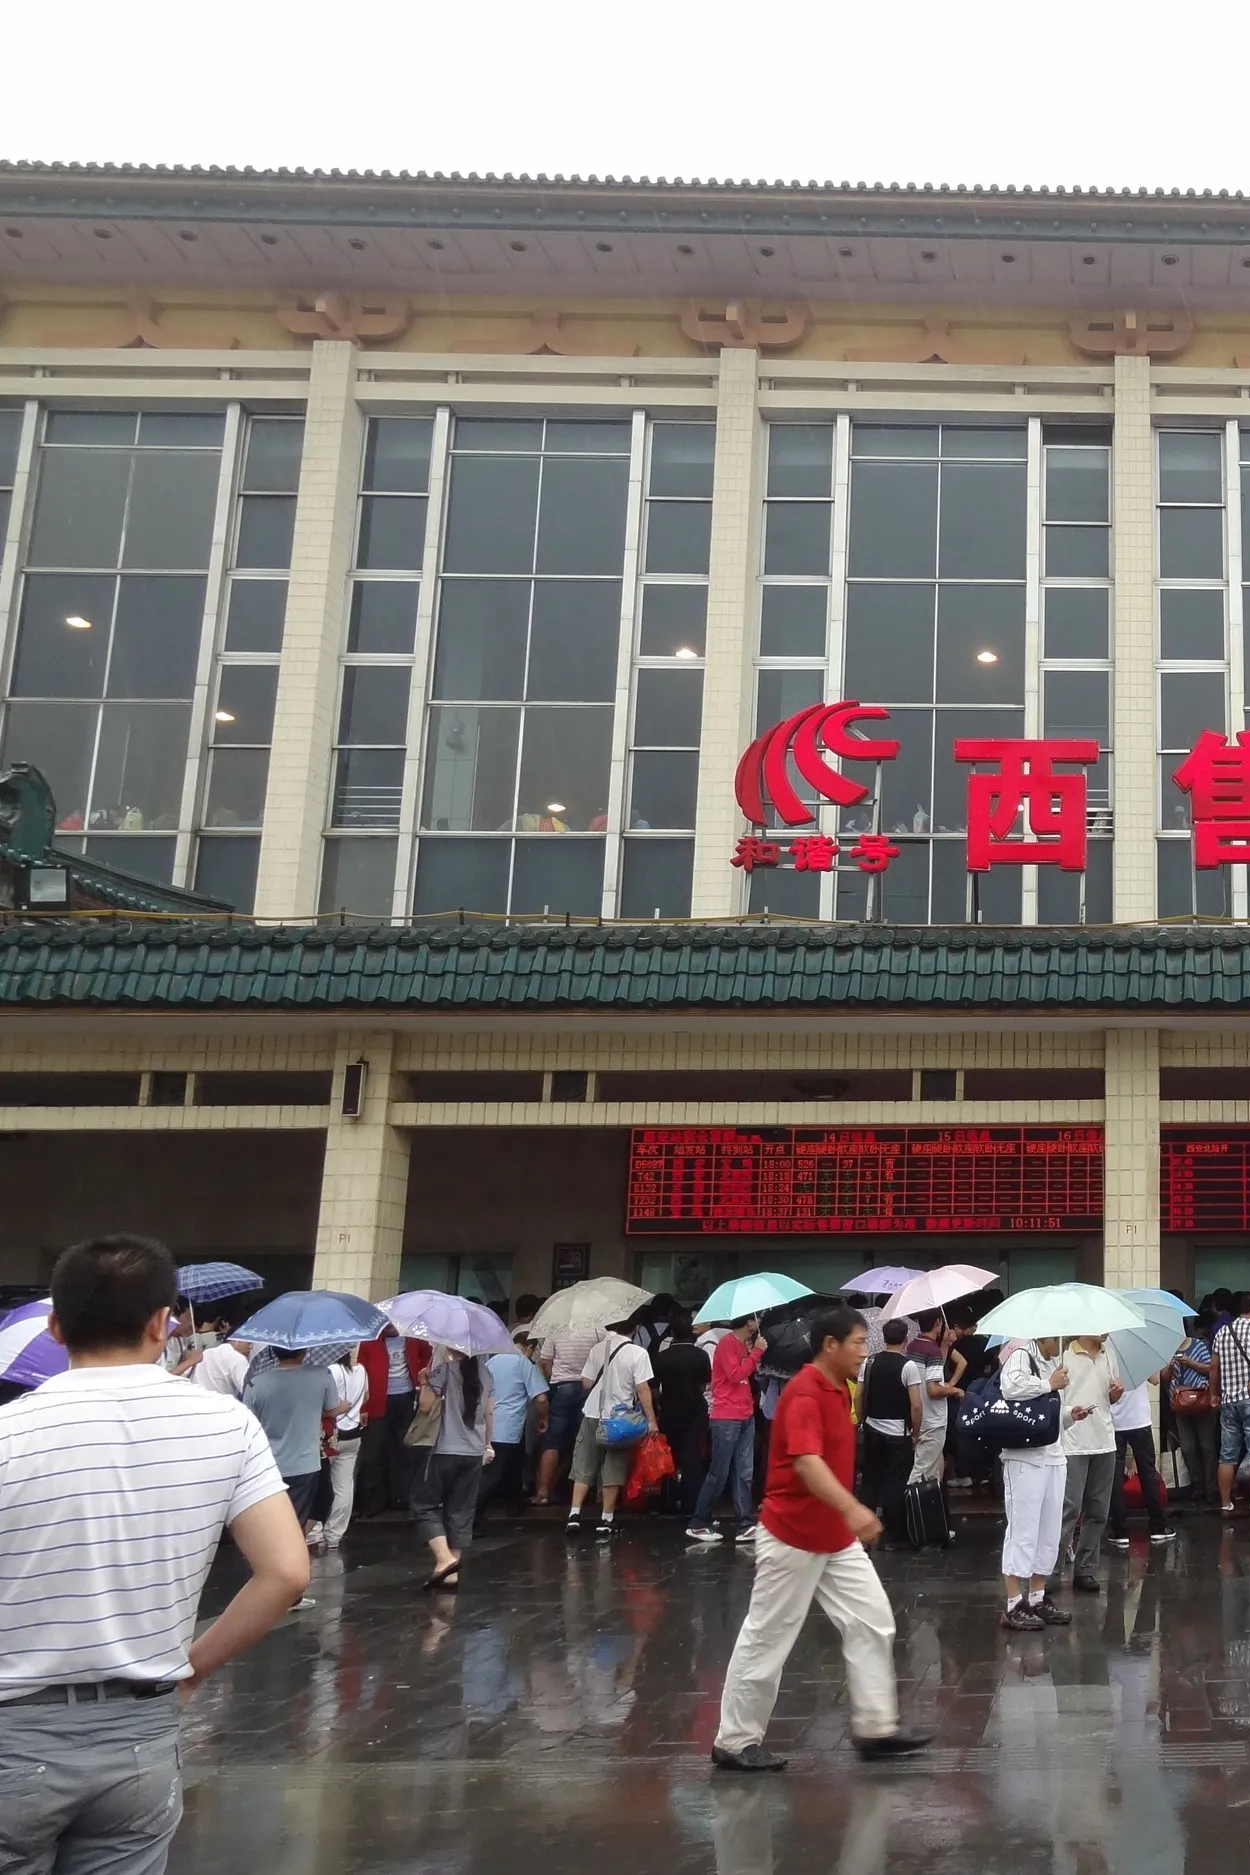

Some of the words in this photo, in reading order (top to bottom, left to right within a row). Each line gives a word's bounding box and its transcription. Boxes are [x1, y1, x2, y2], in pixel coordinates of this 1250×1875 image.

[729, 834, 900, 873] 和谐号
[636, 1145, 659, 1155] 车次
[674, 1145, 706, 1155] 始发站
[721, 1145, 754, 1155] 终到站
[764, 1145, 785, 1155] 开点
[763, 1160, 791, 1169] 18:00
[797, 1160, 814, 1169] 526
[638, 1172, 655, 1181] T42
[763, 1171, 790, 1180] 18:18
[797, 1171, 813, 1180] 471
[762, 1183, 790, 1192] 18:24
[761, 1207, 788, 1216] 18:37
[1010, 1218, 1061, 1228] 10:11:51
[965, 1409, 987, 1427] sport
[1012, 1409, 1037, 1426] sport
